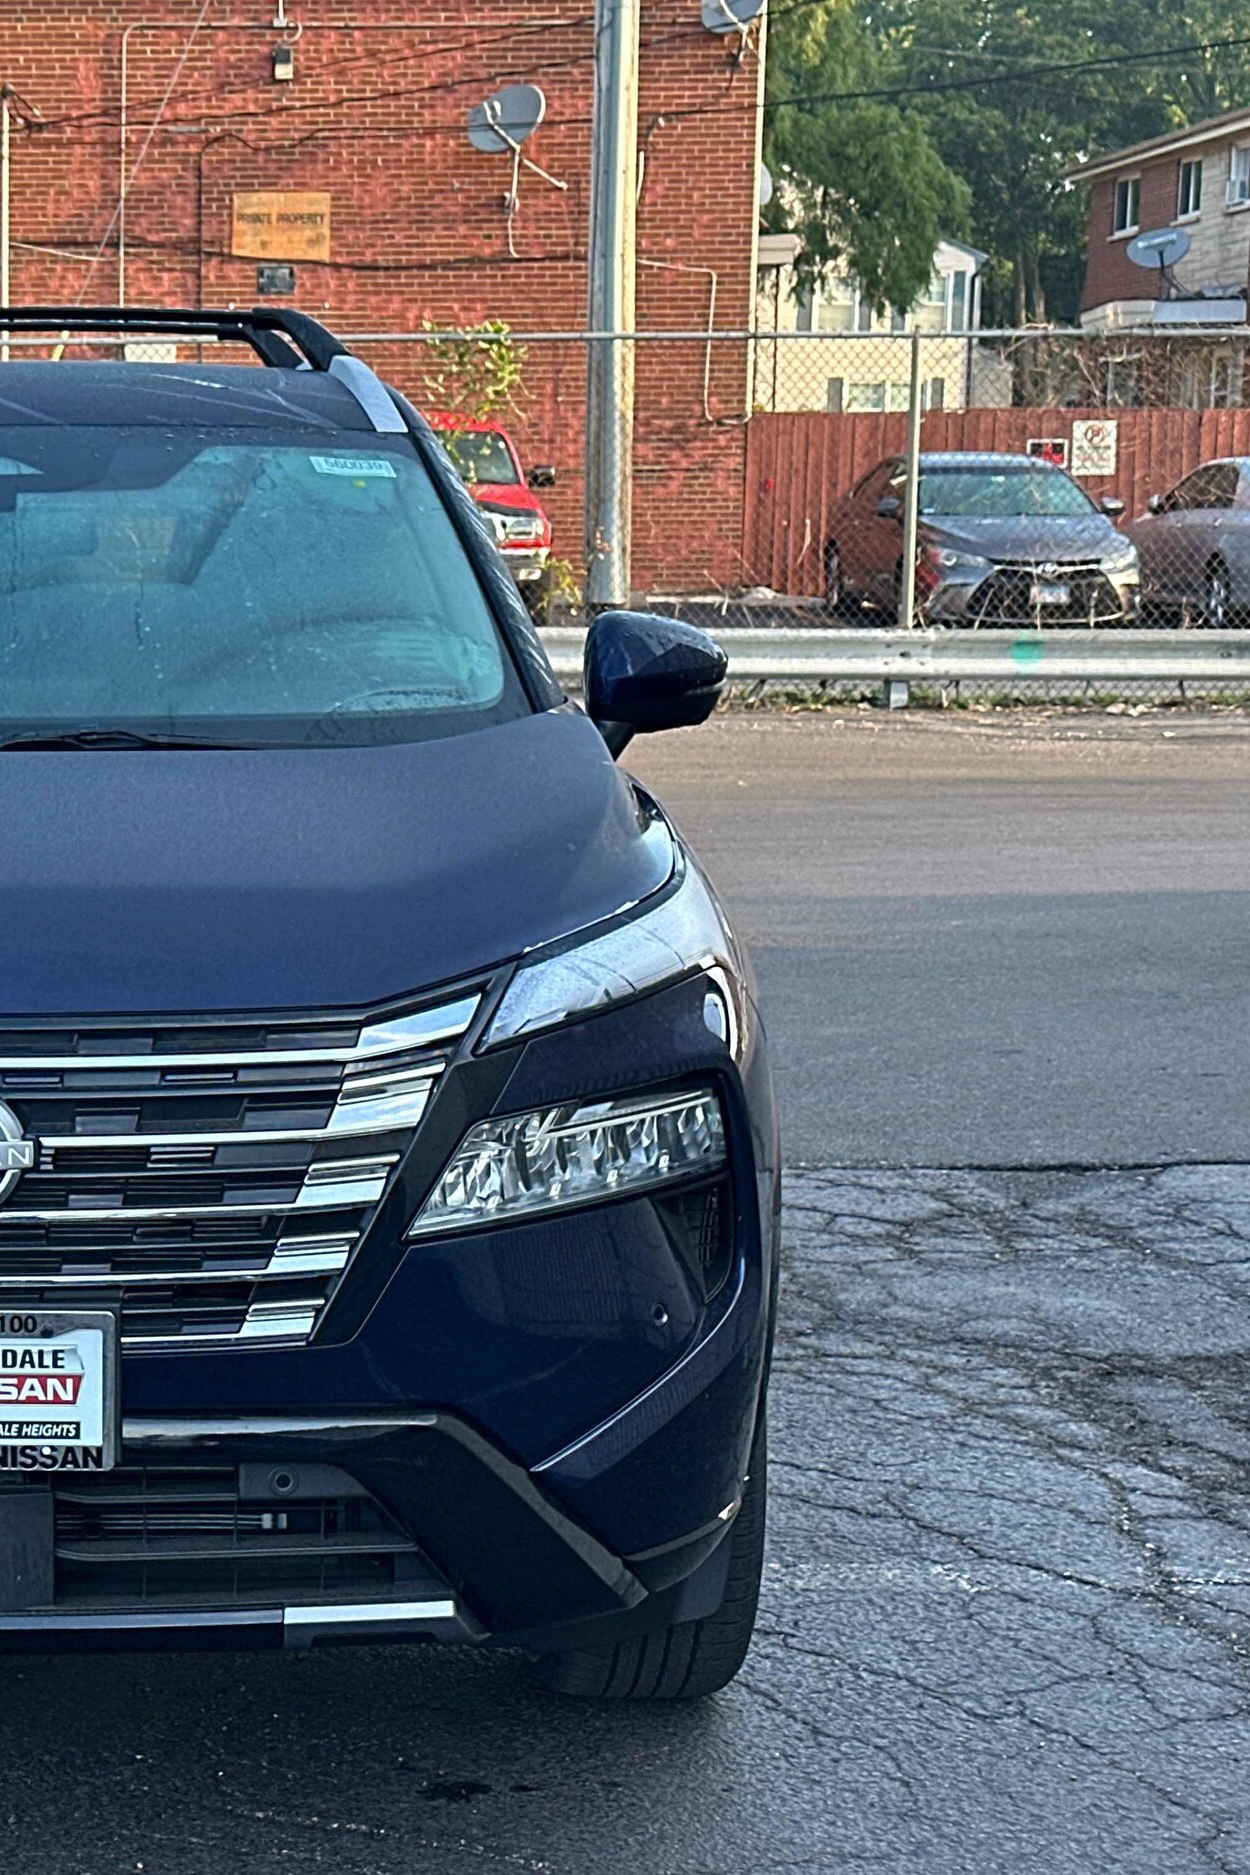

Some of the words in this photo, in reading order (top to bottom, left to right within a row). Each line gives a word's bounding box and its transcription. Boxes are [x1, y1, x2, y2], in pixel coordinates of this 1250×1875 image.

[236, 212, 272, 225] PRIVATE
[276, 212, 326, 225] PROPERTY
[21, 1423, 77, 1437] HEIGHTS
